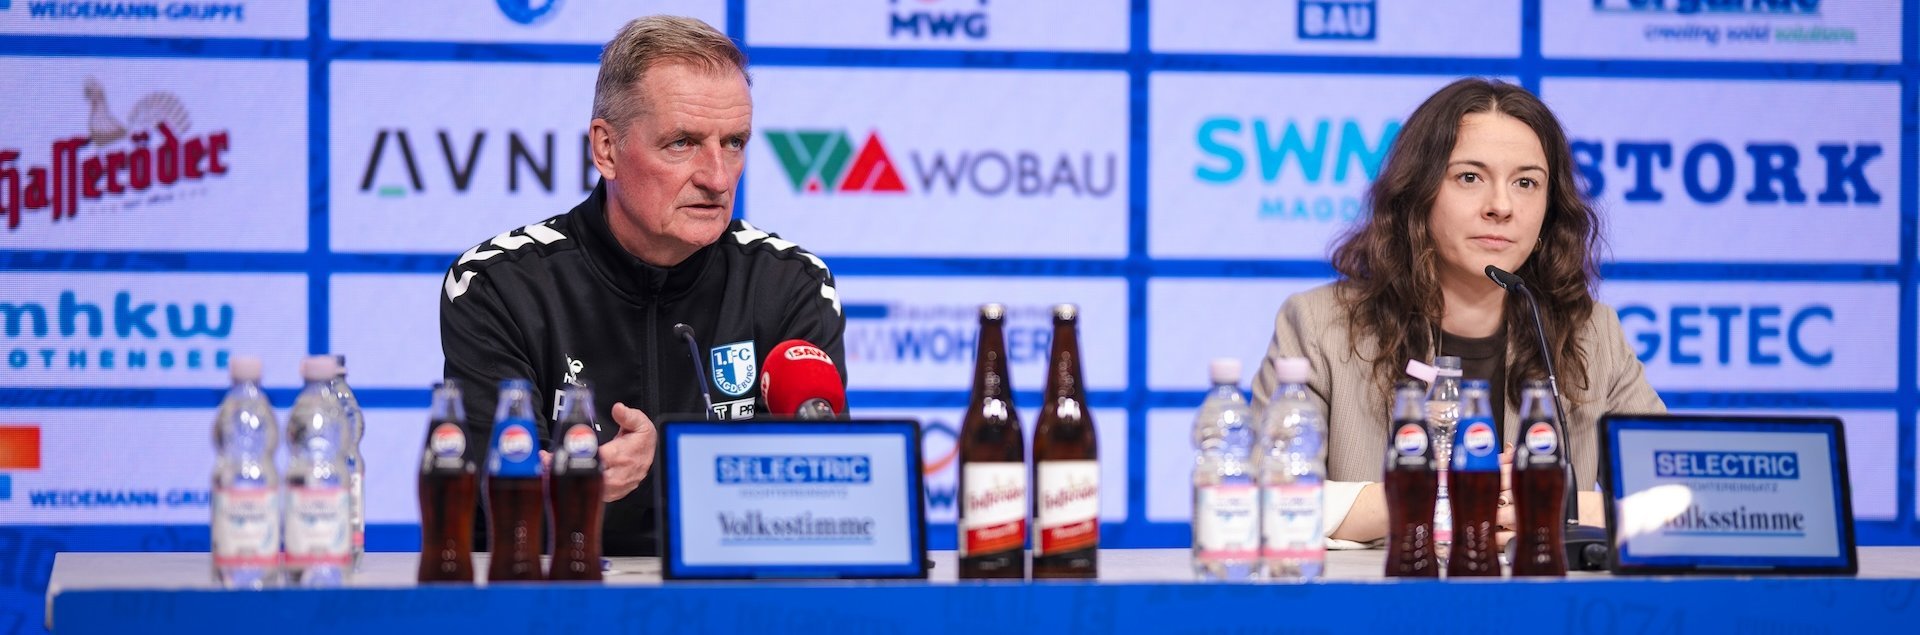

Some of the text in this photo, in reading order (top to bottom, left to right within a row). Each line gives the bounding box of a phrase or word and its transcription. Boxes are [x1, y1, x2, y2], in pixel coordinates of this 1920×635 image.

[29, 2, 244, 22] WEIDEMANN-GRUPPE
[890, 12, 988, 38] MWG
[1303, 4, 1371, 36] BAU
[1196, 118, 1400, 183] SWM
[910, 150, 1116, 196] WOBAU
[1569, 140, 1883, 204] STORK
[1615, 306, 1835, 367] GETEC
[8, 347, 229, 369] OTHENSEE
[715, 364, 754, 392] MAGDEBURG
[719, 458, 868, 482] SELECTRIC
[1656, 452, 1797, 477] SELECTRIC
[719, 511, 876, 537] Volksstimme
[1664, 505, 1806, 532] olksstimme
